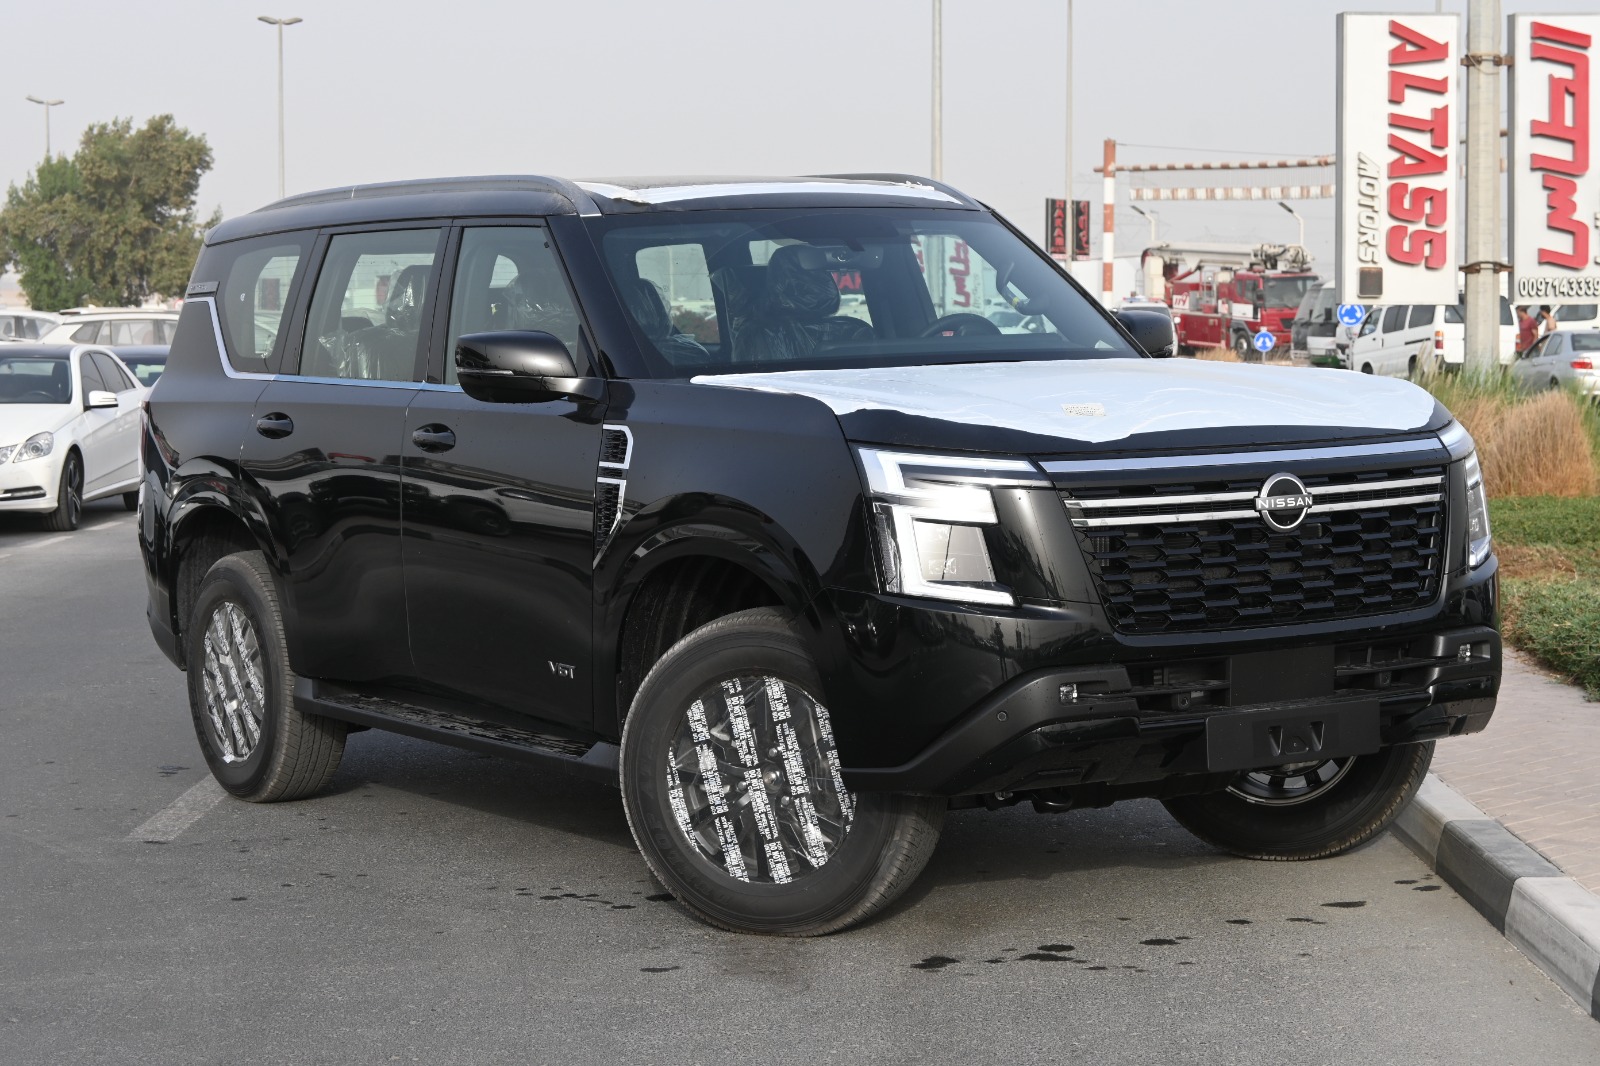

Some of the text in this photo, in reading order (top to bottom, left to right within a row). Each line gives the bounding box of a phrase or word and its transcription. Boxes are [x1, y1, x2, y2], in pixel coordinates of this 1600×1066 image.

[1387, 19, 1449, 271] ALTASS
[1530, 21, 1592, 270] الطاس
[1357, 152, 1381, 263] MOTORS
[1519, 277, 1600, 296] 0097143339
[1258, 496, 1313, 509] NISSAN
[775, 699, 784, 711] NOT
[778, 711, 786, 720] DO
[695, 720, 704, 732] NOT
[698, 732, 705, 741] DO
[787, 750, 800, 773] REMOVE
[749, 769, 756, 778] DO
[793, 773, 803, 786] NOT
[706, 770, 719, 793] REMOVE
[751, 779, 759, 791] NOT
[796, 785, 804, 794] DO
[713, 793, 721, 805] NOT
[754, 790, 766, 814] REMOVE
[716, 805, 724, 814] DO
[769, 842, 777, 851] DO
[772, 851, 781, 863] NOT
